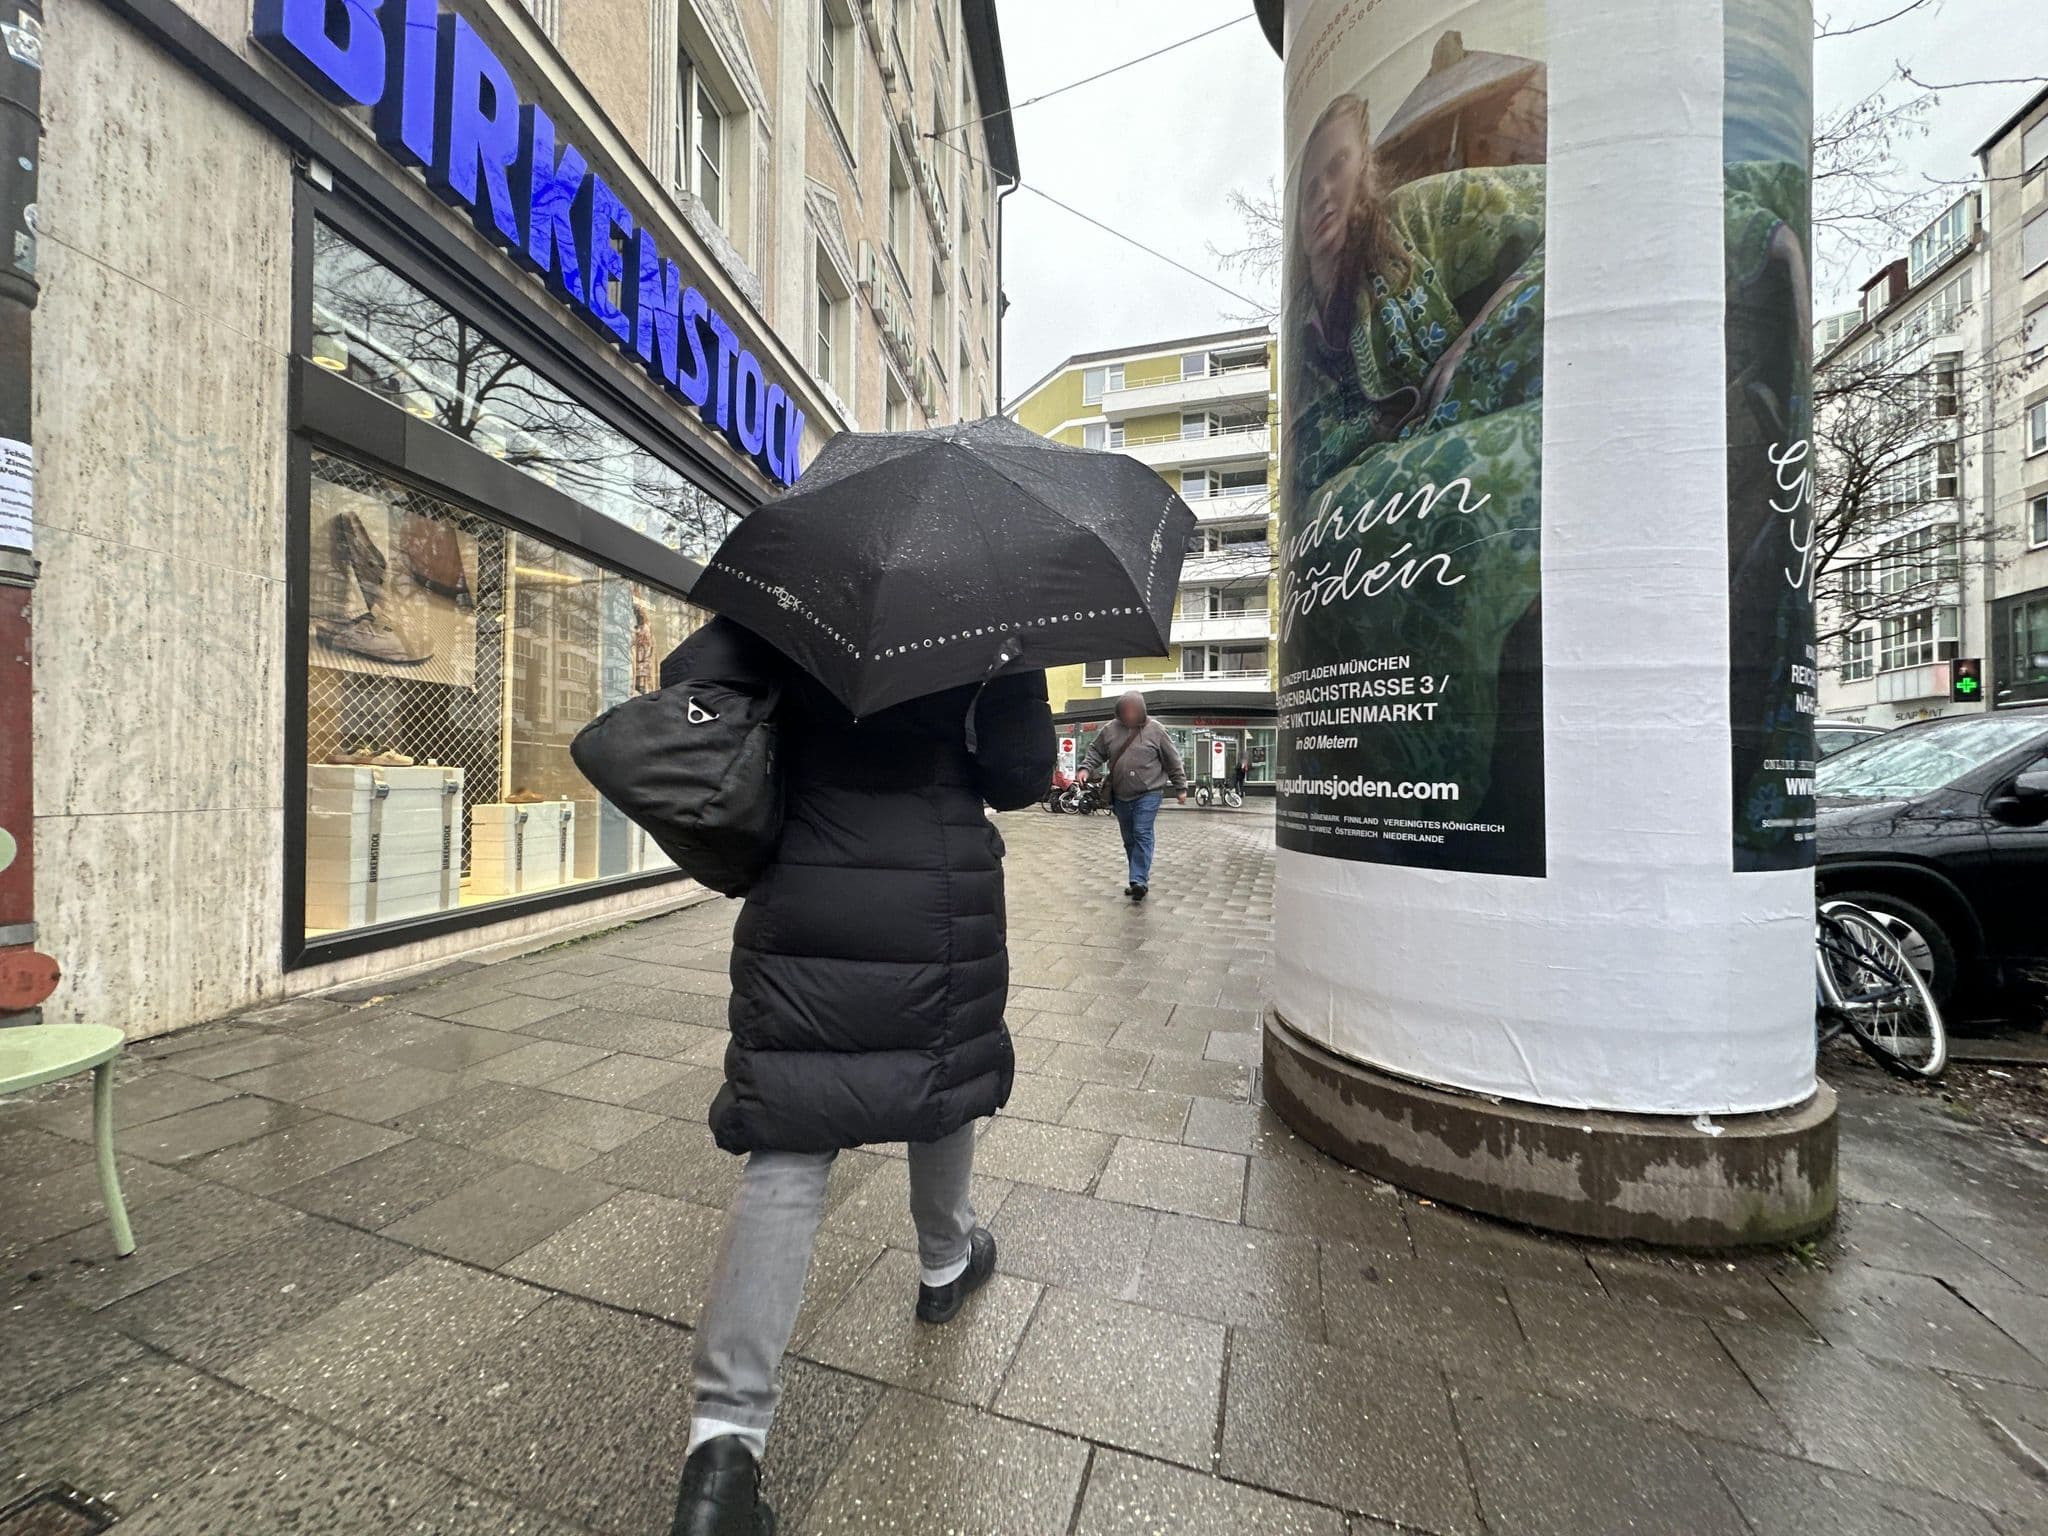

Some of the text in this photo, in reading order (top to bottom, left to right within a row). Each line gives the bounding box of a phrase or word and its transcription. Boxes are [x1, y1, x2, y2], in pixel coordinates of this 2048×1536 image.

[1339, 655, 1410, 676] MÜNCHEN
[1419, 675, 1434, 694] 3
[1439, 674, 1450, 693] /
[1290, 702, 1438, 730] VIKTUALIENMARKT
[1295, 735, 1358, 750] in 80 Metern
[1343, 815, 1379, 826] FINNLAND
[1383, 818, 1441, 830] VEREINIGTES
[1441, 820, 1505, 833] KÖNIGREICH
[1334, 826, 1379, 839] ÖSTERREICH
[1383, 831, 1445, 844] NIEDERLANDE
